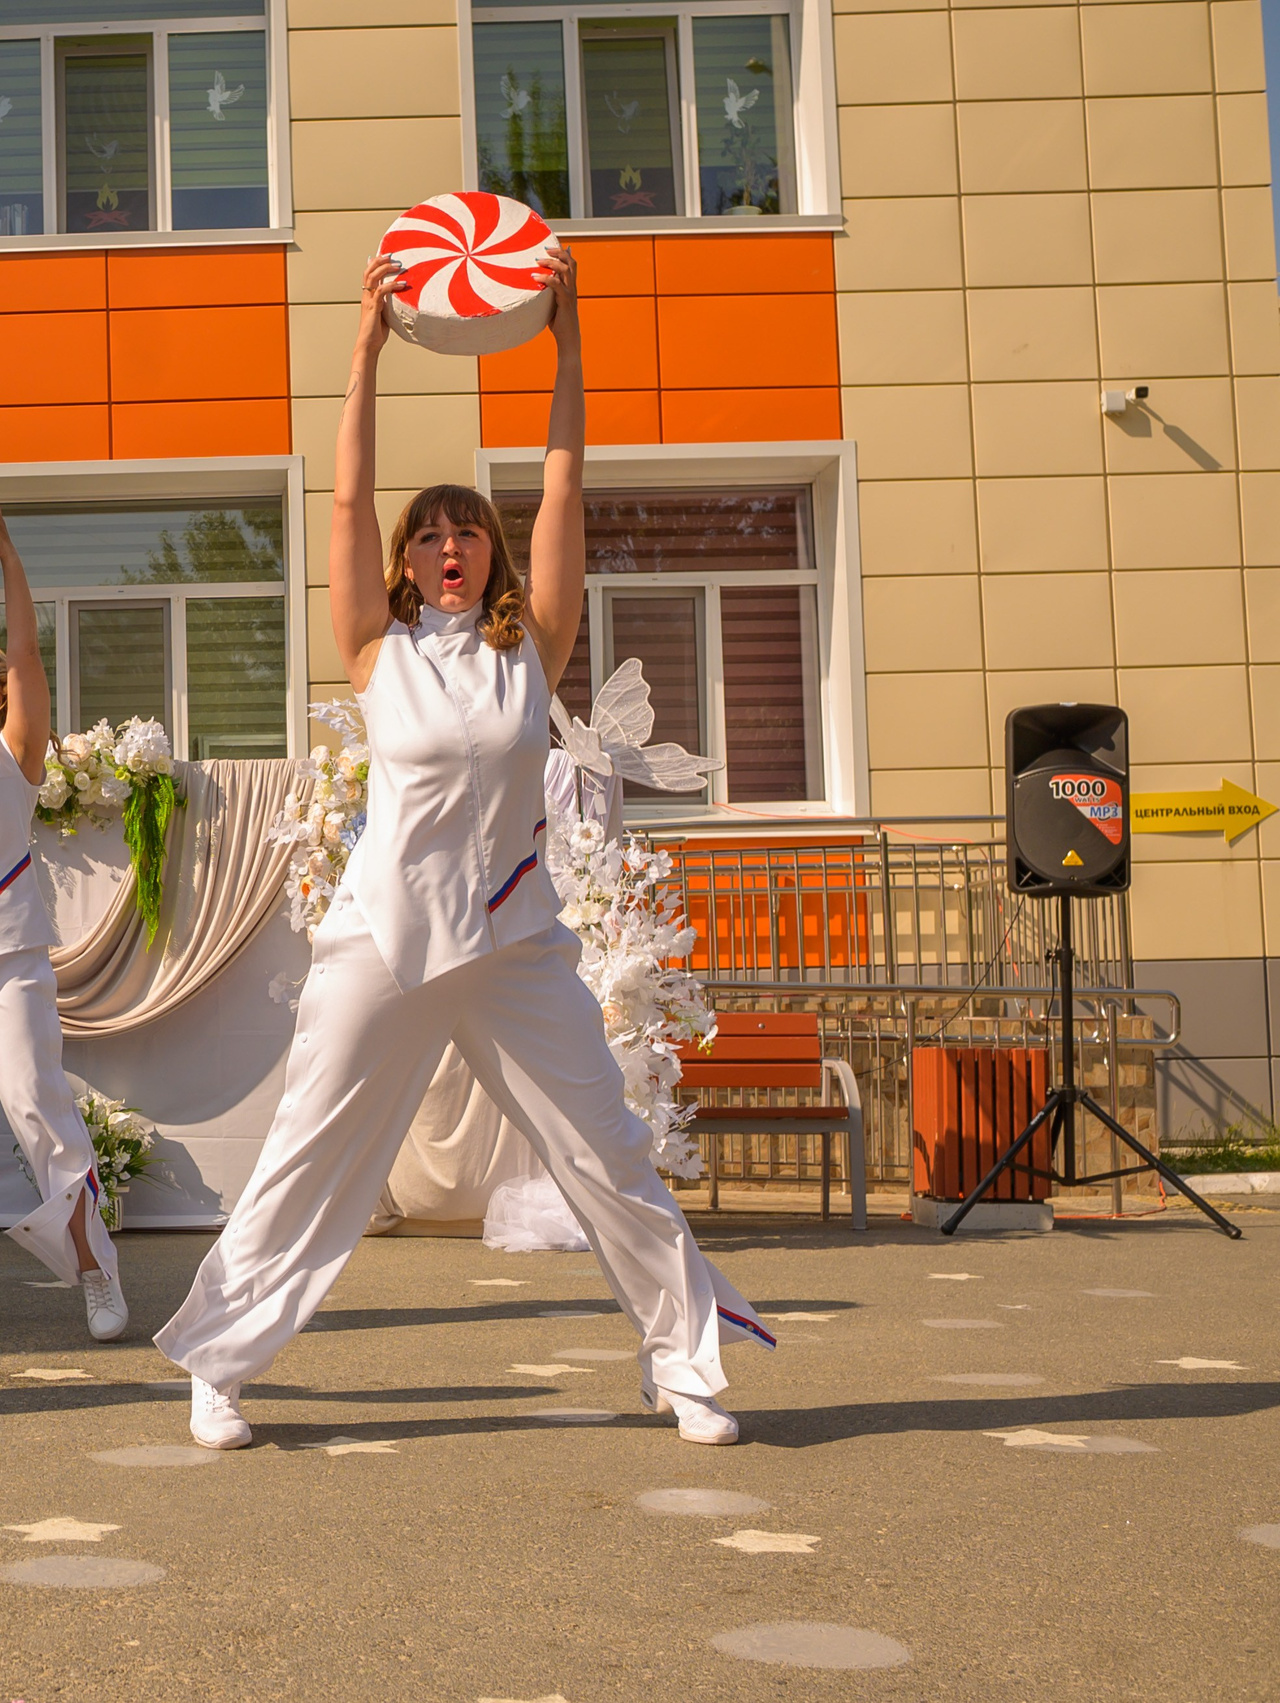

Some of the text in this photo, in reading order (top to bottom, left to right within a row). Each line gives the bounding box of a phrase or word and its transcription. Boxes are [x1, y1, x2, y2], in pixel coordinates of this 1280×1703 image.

[1050, 779, 1106, 798] 1000
[1089, 806, 1119, 817] MP3
[1135, 803, 1260, 819] ЦЕНТРАЛЬНЫЙ ВХОД
